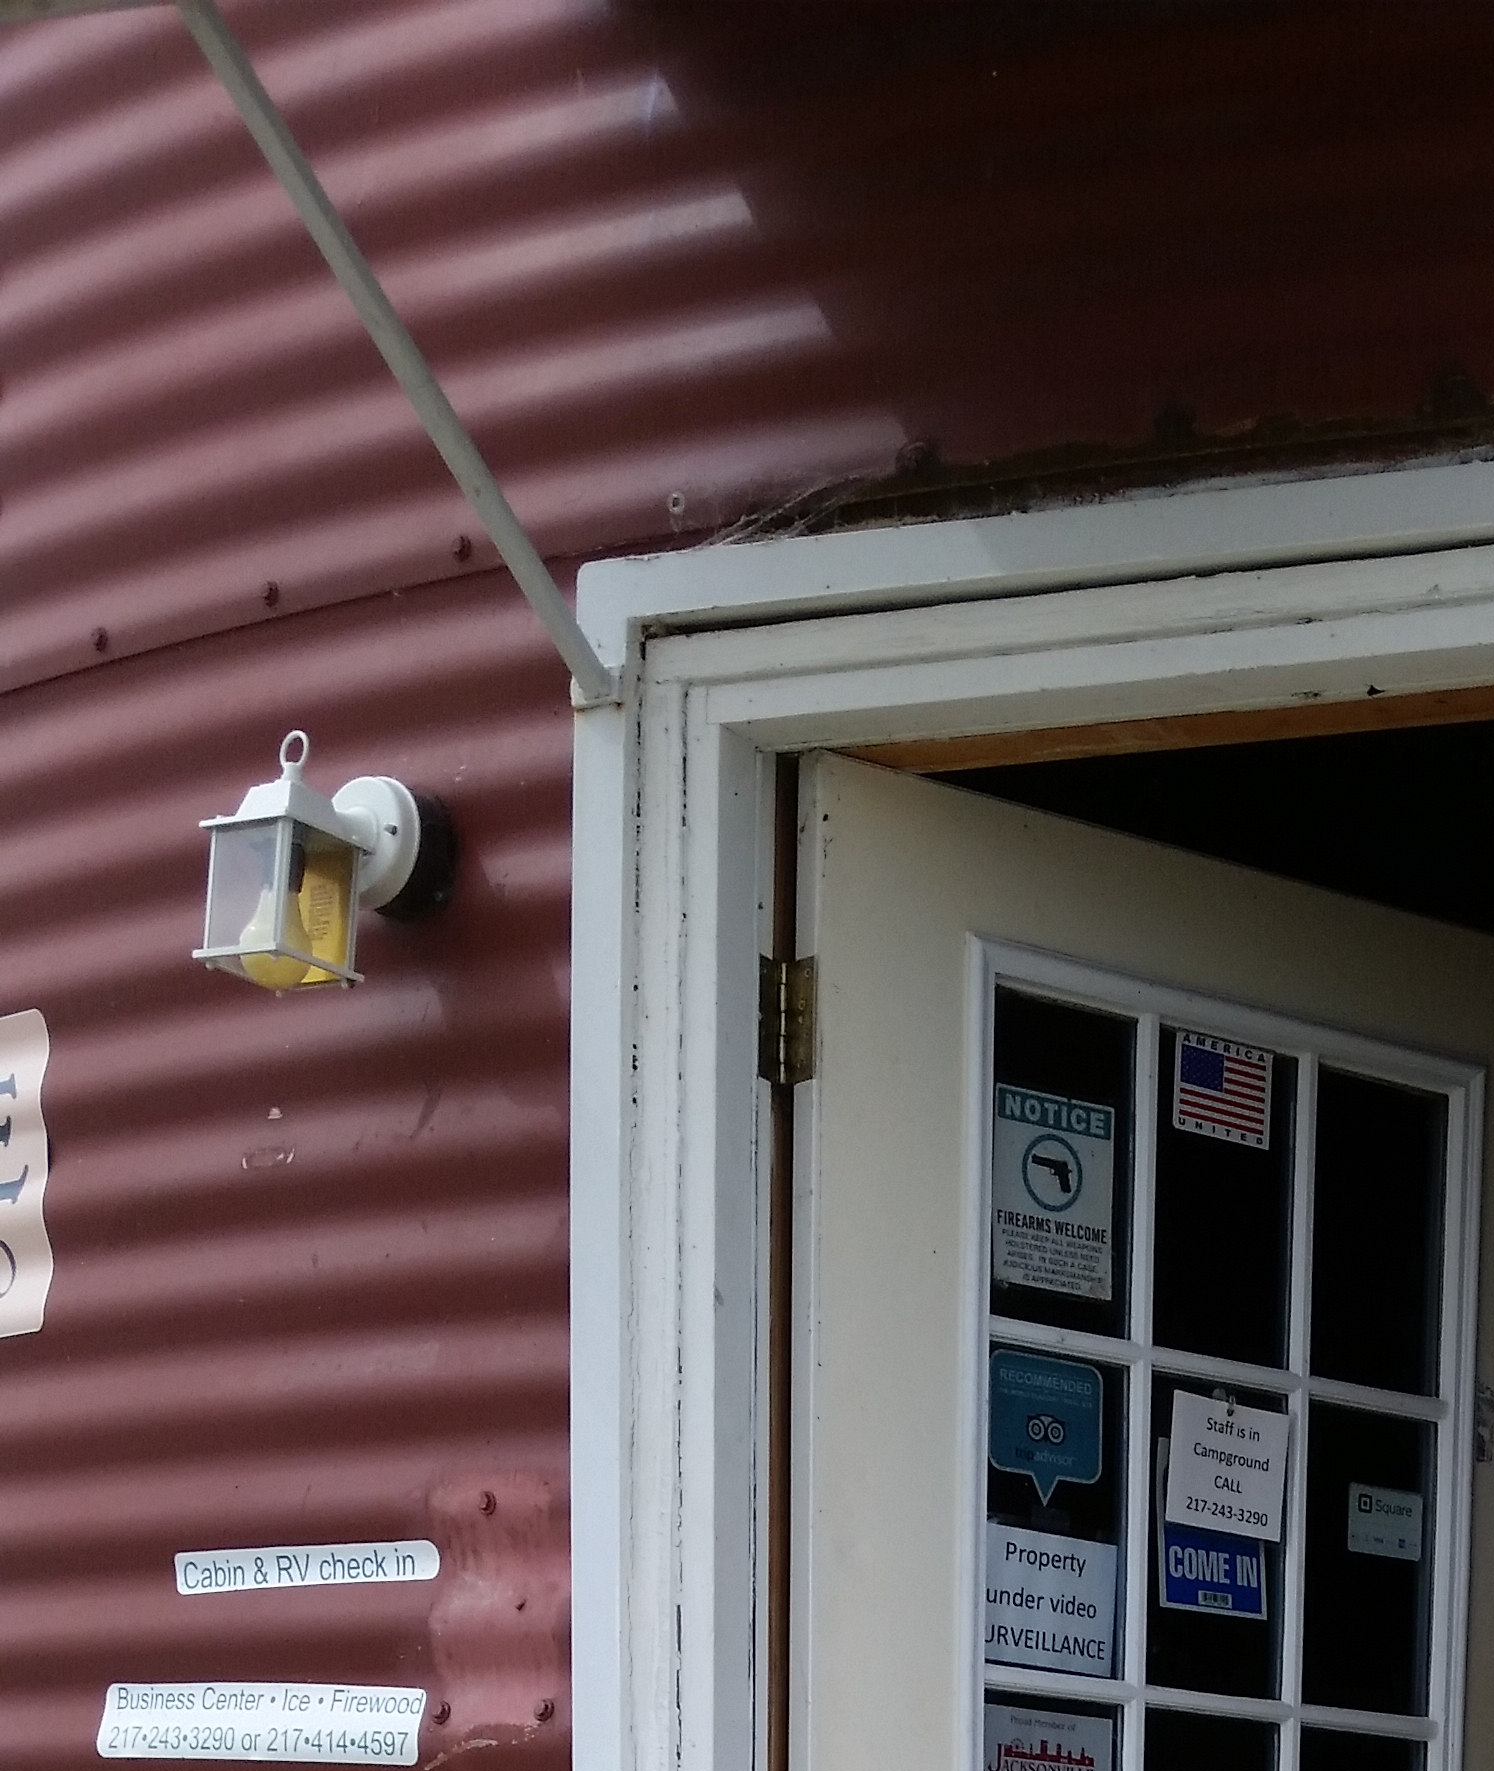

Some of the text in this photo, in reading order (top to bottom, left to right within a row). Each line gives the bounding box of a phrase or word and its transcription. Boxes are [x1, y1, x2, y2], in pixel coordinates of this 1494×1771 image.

[1183, 1034, 1266, 1062] AMERICA
[1005, 1093, 1105, 1136] NOTICE
[1179, 1117, 1263, 1145] UNITED
[997, 1209, 1107, 1244] FIREARMS WELCOME
[1000, 1368, 1092, 1395] RECOMMENDED
[1206, 1417, 1260, 1442] Staff is in
[1016, 1446, 1074, 1465] tripadvisor
[1193, 1442, 1270, 1472] Campground
[1214, 1475, 1243, 1494] CALL
[1186, 1496, 1268, 1527] 217-243-3290
[1375, 1499, 1412, 1518] Square
[184, 1548, 415, 1589] Cabin & RV check in
[1005, 1541, 1087, 1578] Property
[1169, 1545, 1258, 1588] COME IN
[986, 1587, 1097, 1619] under video
[985, 1624, 1106, 1660] URVEILLANCE
[117, 1687, 424, 1715] Business Center Ice Firewood
[1034, 1717, 1065, 1730] Member
[1067, 1724, 1076, 1732] of
[241, 1731, 260, 1751] or
